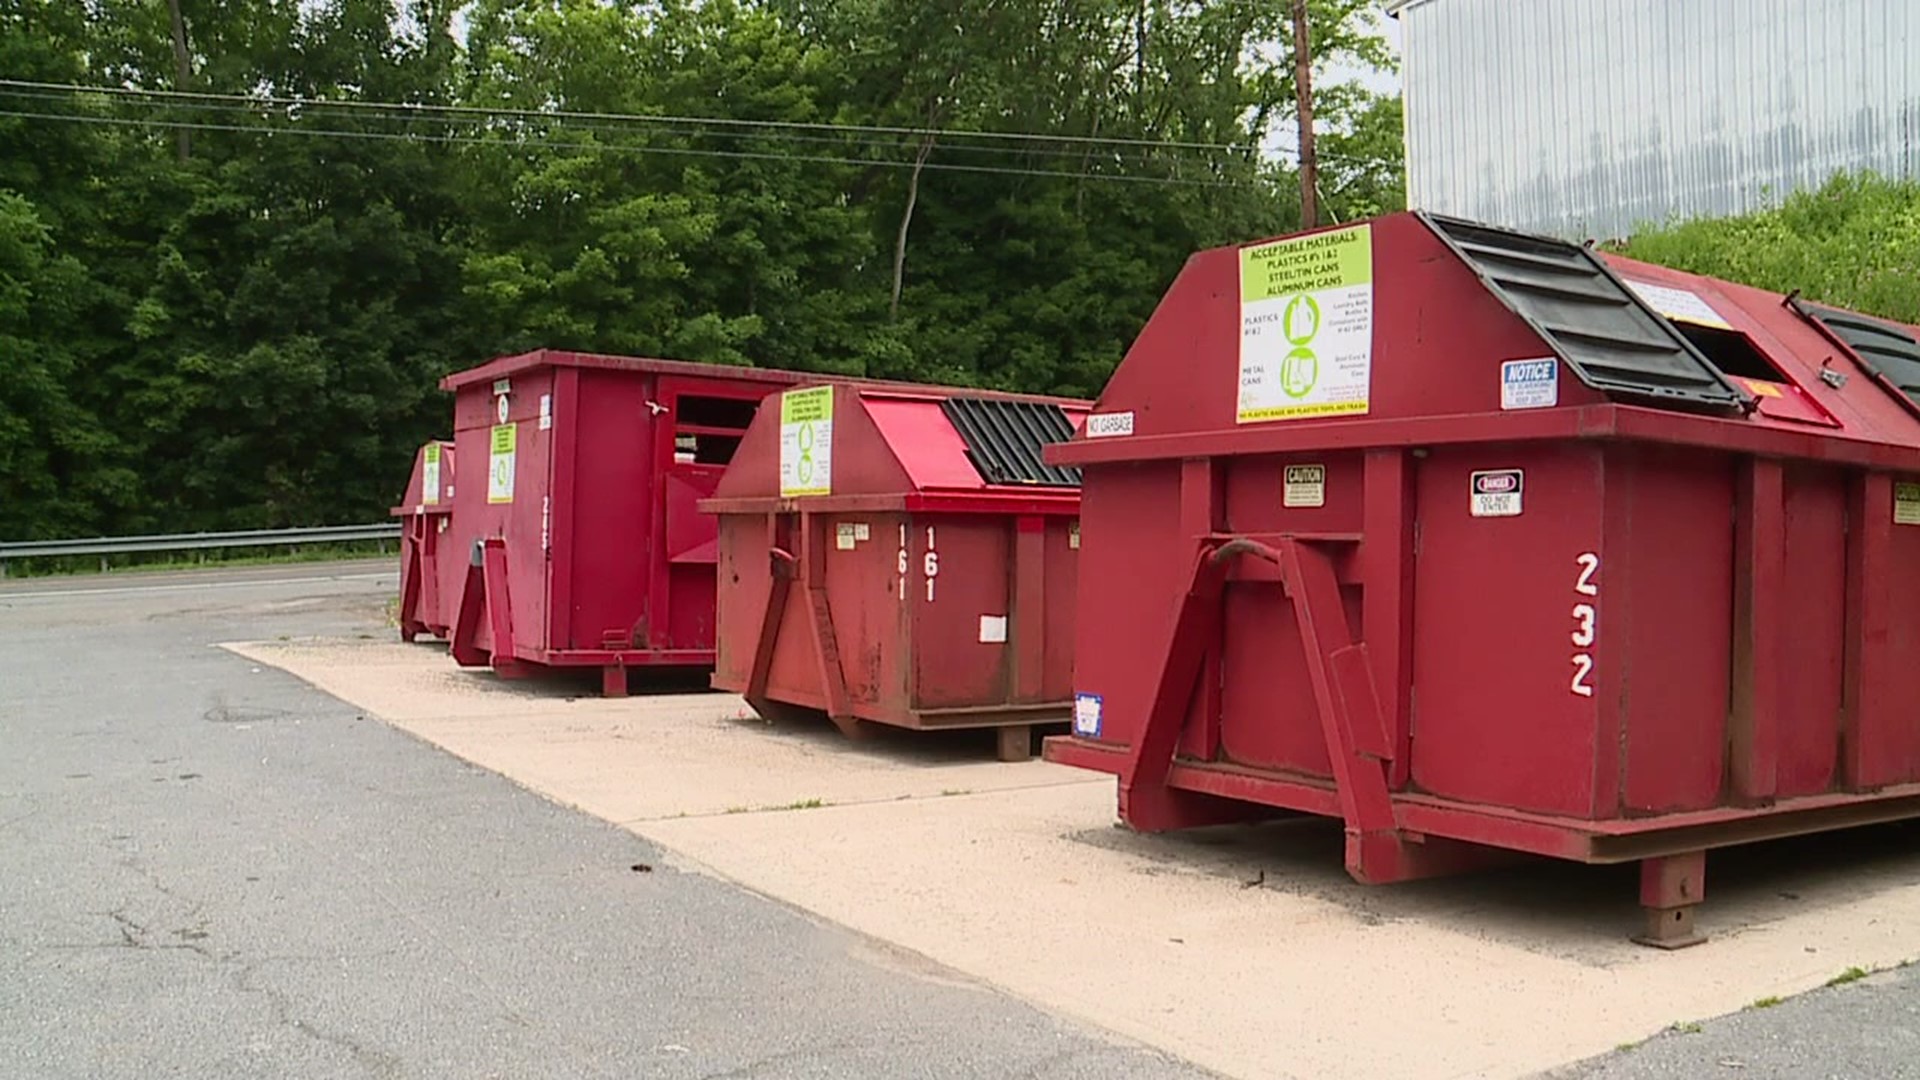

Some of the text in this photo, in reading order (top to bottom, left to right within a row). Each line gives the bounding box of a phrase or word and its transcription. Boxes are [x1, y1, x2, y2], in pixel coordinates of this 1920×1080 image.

[1250, 241, 1304, 260] ACCEPTABLE
[1267, 253, 1308, 269] PLASTICS
[1314, 263, 1340, 275] CANS
[1267, 276, 1342, 296] ALUMINUM CANS
[1508, 363, 1551, 381] NOTICE
[1241, 377, 1262, 387] CANS
[1100, 415, 1131, 432] GARBAGE
[1288, 467, 1321, 482] CAUTION
[924, 526, 938, 602] 161
[1571, 552, 1599, 697] 232
